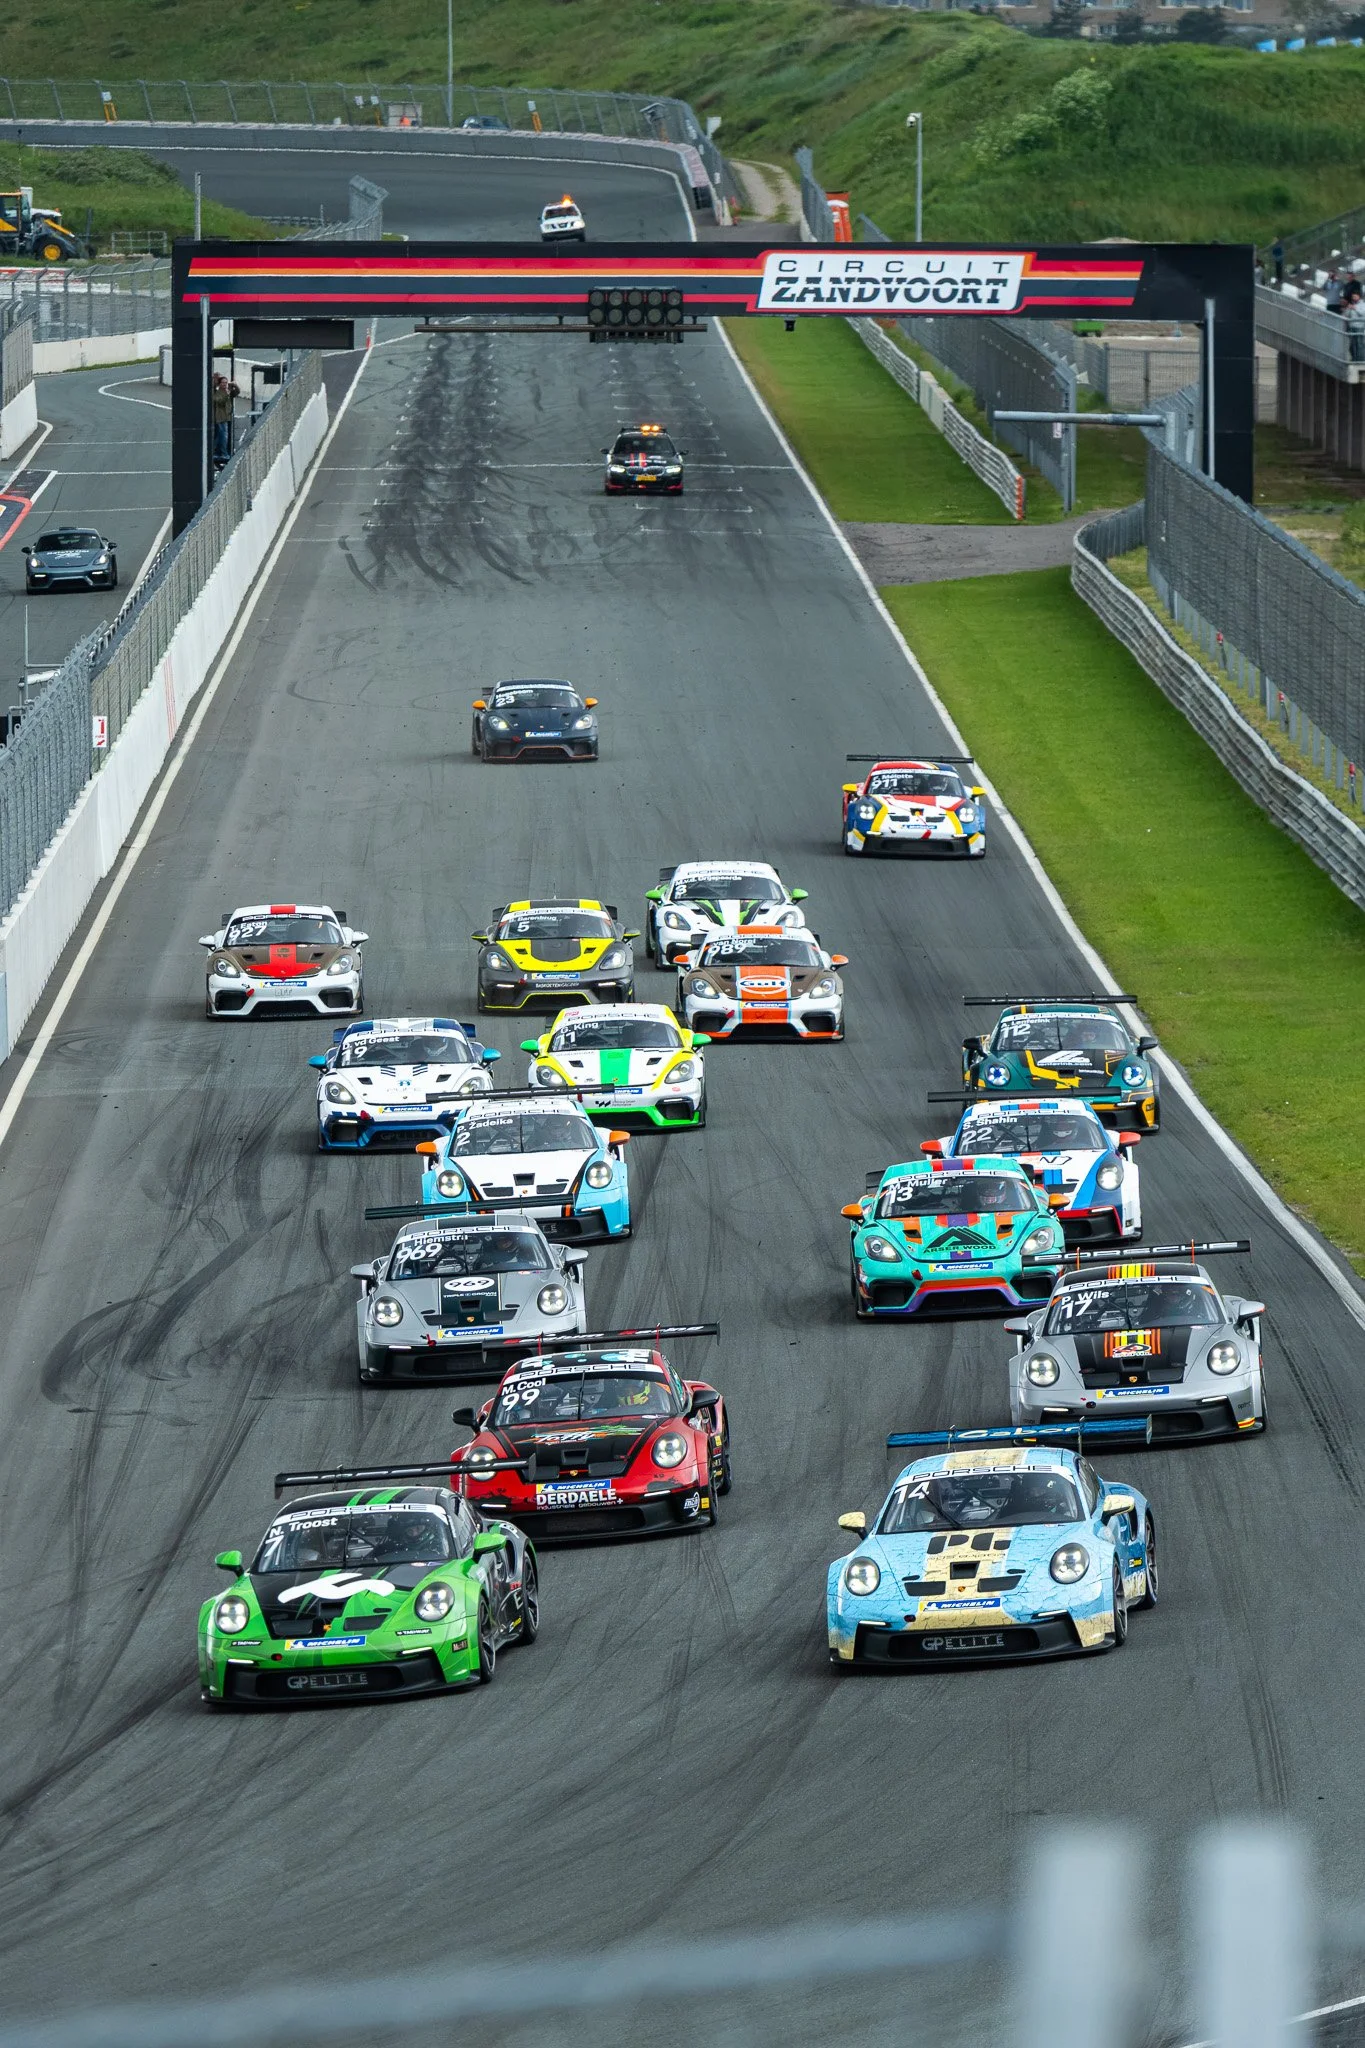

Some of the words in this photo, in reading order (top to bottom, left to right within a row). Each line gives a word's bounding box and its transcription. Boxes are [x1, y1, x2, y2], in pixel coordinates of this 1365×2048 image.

[778, 259, 1010, 274] CIRCUIT
[771, 276, 1009, 304] ZANDVOORT
[495, 696, 515, 707] 23
[871, 779, 898, 790] 911
[675, 885, 687, 895] 3
[240, 921, 268, 929] Eaton
[517, 920, 530, 932] 5
[228, 925, 267, 941] 927
[707, 942, 748, 956] 989
[568, 1013, 660, 1021] PORSCHE
[1011, 1017, 1051, 1027] Lenferink
[560, 1026, 572, 1034] G.
[573, 1022, 599, 1030] King
[1000, 1023, 1031, 1039] 112
[342, 1042, 353, 1051] D.
[354, 1038, 367, 1046] vd
[555, 1031, 576, 1046] 11
[341, 1046, 368, 1062] 19
[469, 1109, 571, 1120] PORSCHE
[977, 1108, 1080, 1119] PORSCHE
[456, 1125, 467, 1134] P.
[962, 1121, 975, 1131] S.
[976, 1116, 1018, 1126] Shahin
[456, 1131, 471, 1147] 2
[961, 1126, 993, 1145] 22
[898, 1170, 1008, 1182] PORSCHE
[889, 1183, 902, 1191] M.
[885, 1187, 914, 1204] 13
[409, 1225, 525, 1239] PORSCHE
[414, 1234, 469, 1247] Hiemstra
[396, 1242, 443, 1264] 969
[1034, 1241, 1238, 1261] PORSCHE
[449, 1279, 490, 1288] 969
[1068, 1275, 1194, 1291] PORSCHE
[1061, 1295, 1076, 1306] P.
[1078, 1290, 1110, 1301] Wils
[1061, 1299, 1093, 1319] 17
[455, 1328, 500, 1336] MICHELIN
[519, 1364, 647, 1379] PORSCHE
[1117, 1388, 1164, 1396] MICHELIN
[501, 1388, 541, 1412] 99
[912, 1465, 1053, 1482] PORSCHE
[556, 1482, 606, 1490] MICHELIN
[893, 1481, 931, 1505] 14
[536, 1488, 617, 1506] DERDAELE
[578, 1500, 617, 1508] gebouwen
[290, 1503, 428, 1520] PORSCHE
[269, 1527, 285, 1538] N.
[288, 1517, 339, 1532] Troost
[265, 1535, 285, 1558] 7
[940, 1600, 996, 1609] MICHELIN
[306, 1637, 361, 1648] MICHELIN
[945, 1633, 1005, 1650] ELITE
[309, 1673, 369, 1687] ELITE
